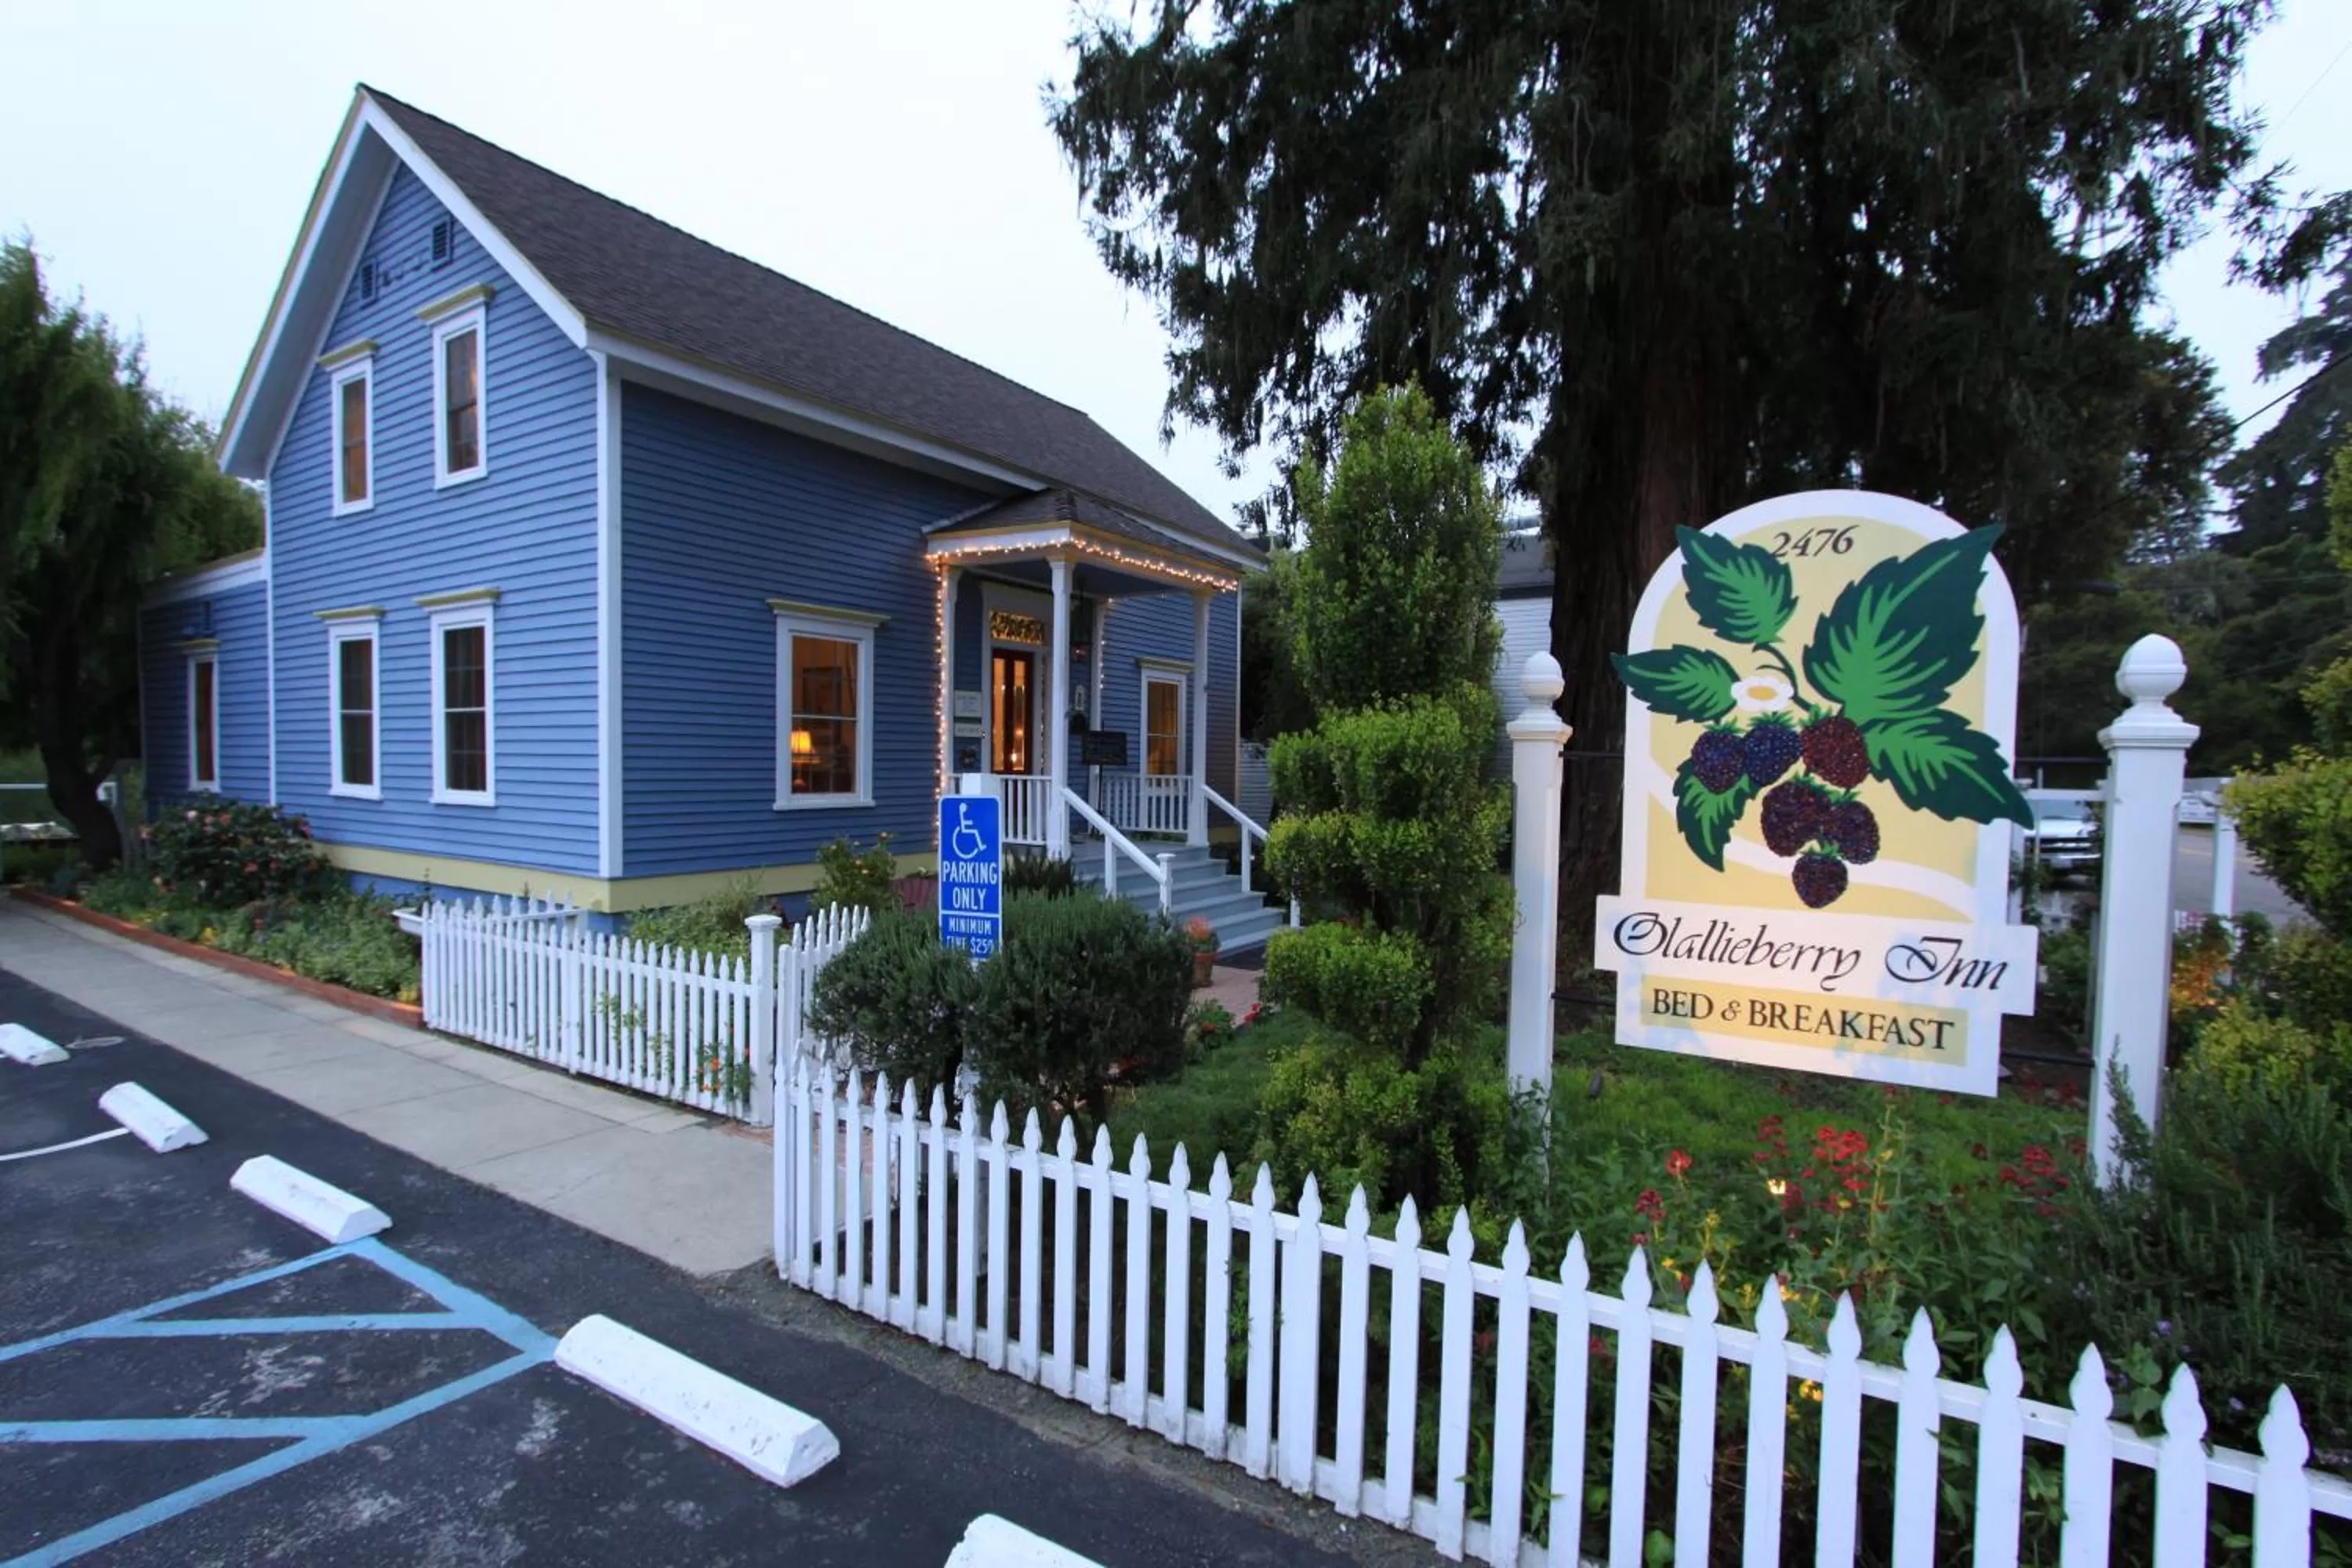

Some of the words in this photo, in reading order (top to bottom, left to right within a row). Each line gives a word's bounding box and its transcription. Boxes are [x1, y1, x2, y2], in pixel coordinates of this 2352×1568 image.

[1773, 524, 1860, 557] 2476
[942, 861, 998, 885] PARKING
[952, 887, 987, 911] ONLY
[948, 916, 992, 935] MINIMUM
[1613, 912, 1860, 993] Olallieberry
[1884, 935, 2009, 991] Inn
[1652, 988, 1714, 1019] BED
[1720, 1000, 1742, 1022] &
[1748, 999, 1955, 1051] BREAKFAST
